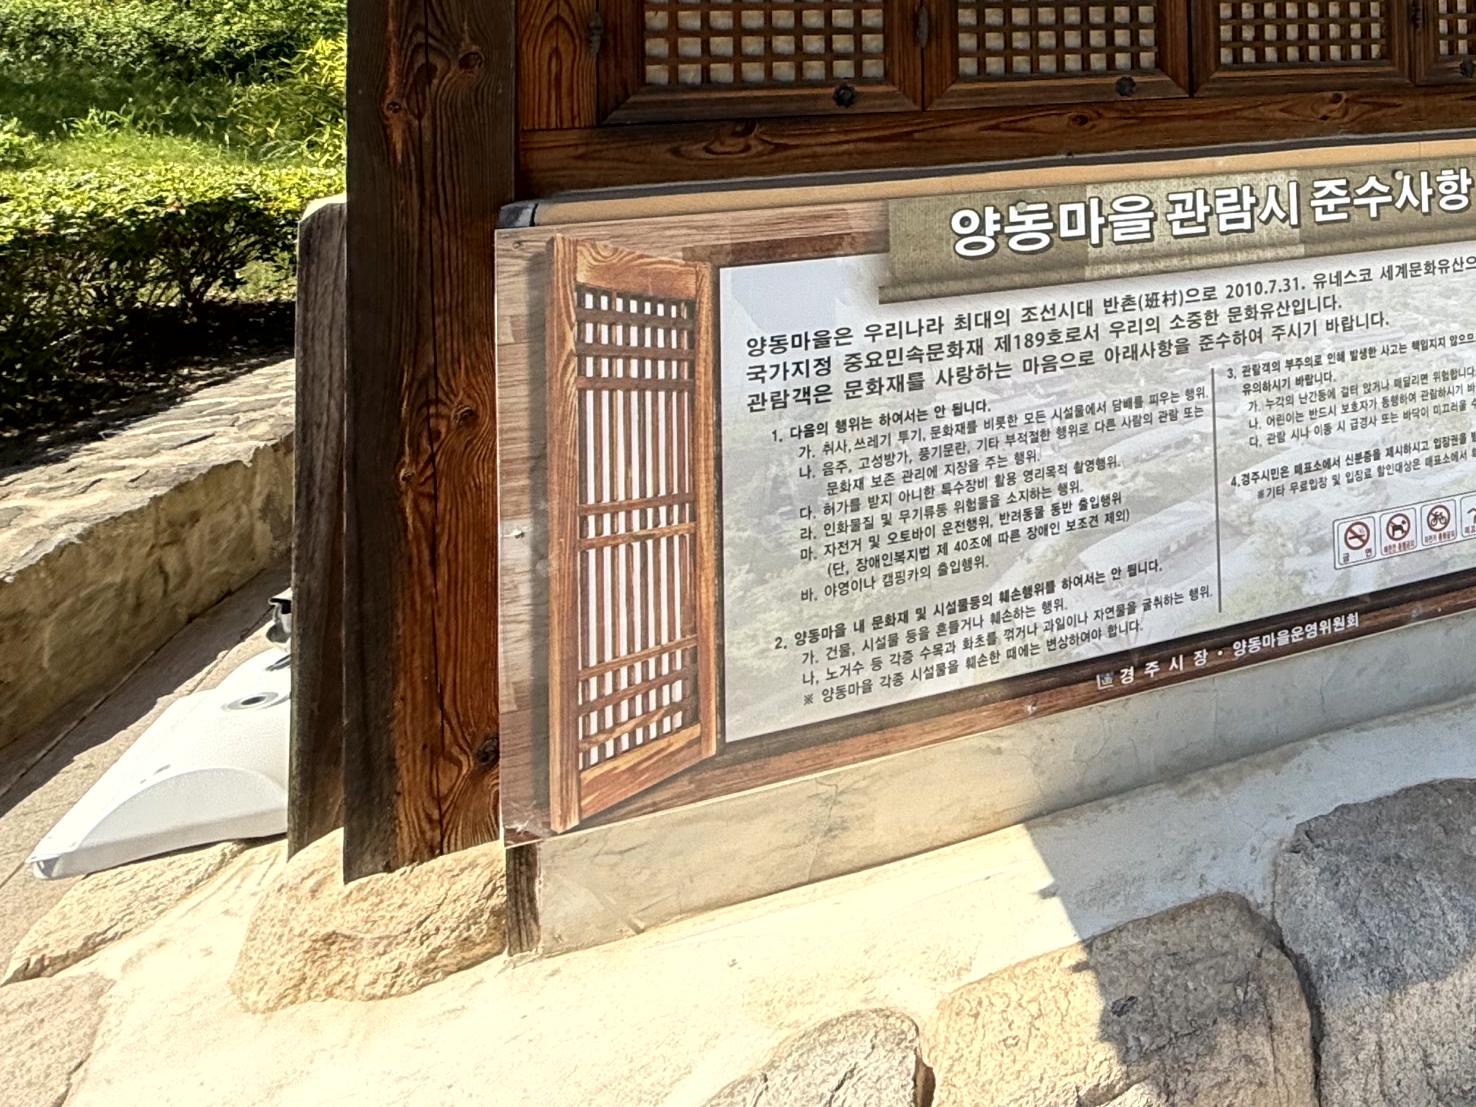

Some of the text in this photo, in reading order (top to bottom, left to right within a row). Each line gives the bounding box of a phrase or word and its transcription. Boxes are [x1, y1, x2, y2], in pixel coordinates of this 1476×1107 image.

[951, 167, 1472, 259] 양동마을 관람시 준수사항
[745, 326, 854, 357] 양동마을은
[863, 315, 944, 343] 우리나라
[953, 307, 1010, 332] 최대의
[1020, 298, 1093, 323] 조선시대
[1225, 276, 1305, 299] 2010.7.31.
[1312, 267, 1373, 289] 유네스코
[745, 293, 1342, 384] 국가지정 중요민속문화재 제189호로서 우리의 소중한 문화유산입니다.
[746, 310, 1389, 413] 관람객은 문화재를 사랑하는 마음으로 아래사항을 준수하여 주시기 바랍니다.
[1226, 367, 1237, 379] 3.
[1241, 359, 1281, 378] 관람객의
[1284, 353, 1323, 371] 부주의로
[1326, 349, 1345, 365] 인해
[1348, 345, 1377, 362] 발생한
[1379, 342, 1407, 356] 사고는
[1410, 335, 1446, 352] 책임지지
[771, 398, 991, 442] 1. 다음의 행위는 하여서는 안 됩니다.
[797, 443, 815, 459] 가.
[897, 427, 926, 444] 투기,
[929, 418, 978, 440] 문화재를
[982, 413, 1018, 431] 비롯한
[1022, 409, 1046, 426] 모든
[1050, 400, 1106, 422] 시설물에서
[1111, 394, 1144, 413] 담배를
[1148, 390, 1180, 406] 피우는
[1184, 385, 1208, 402] 행위.
[857, 449, 912, 470] 고성방가,
[917, 440, 970, 462] 풍기문란,
[976, 435, 1000, 451] 기타
[1004, 427, 1051, 447] 부적절한
[1055, 421, 1089, 440] 행위로
[1094, 417, 1116, 433] 다른
[1120, 411, 1153, 429] 사람의
[1157, 407, 1179, 424] 관람
[1182, 404, 1204, 419] 또는
[798, 454, 1121, 520] 다. 허가를 받지 아니한 특수장비 활용 영리목적 촬영행위.
[826, 508, 1130, 578] (단, 장애인복지법 제 40조에 따른 장애인 보조견 제외)
[1231, 611, 1359, 660] 양동마을운영위원회
